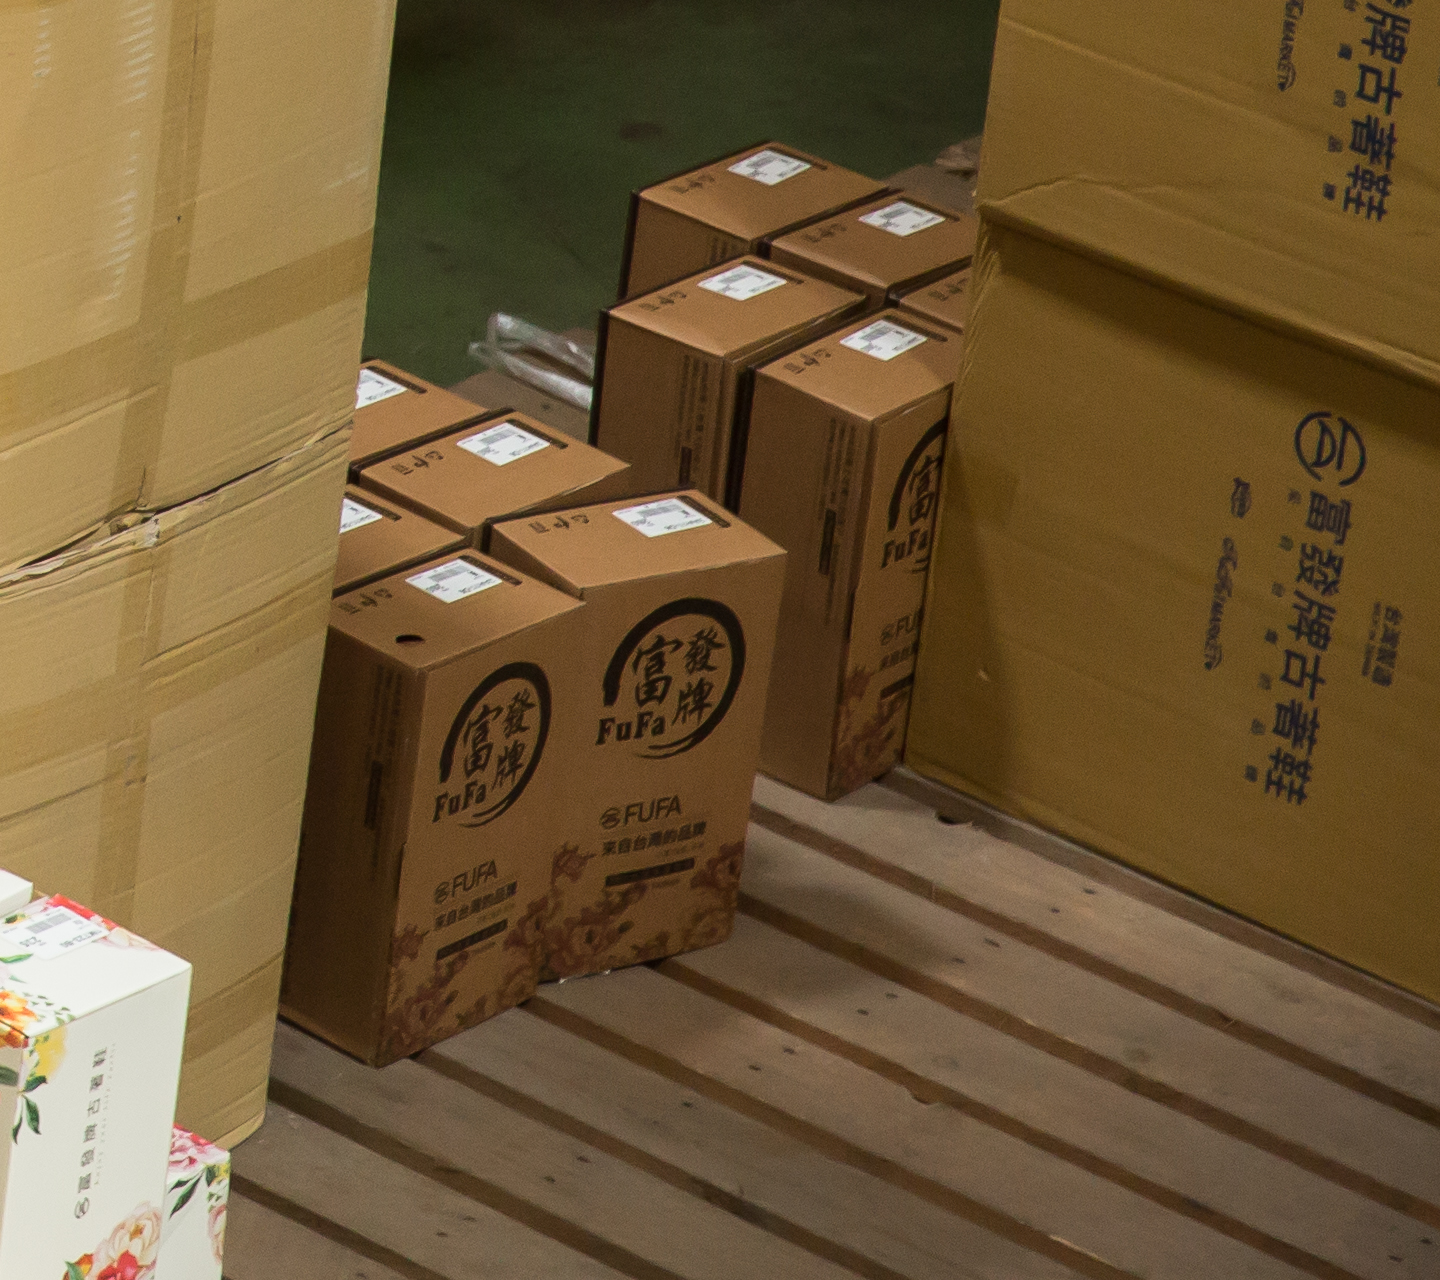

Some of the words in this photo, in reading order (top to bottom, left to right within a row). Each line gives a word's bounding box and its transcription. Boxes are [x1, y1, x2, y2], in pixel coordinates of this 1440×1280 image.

[1264, 491, 1352, 808] 富發牌古著鞋
[632, 627, 722, 728] 富發牌
[463, 689, 537, 790] 富發牌
[595, 712, 666, 746] FuFa
[433, 778, 488, 822] FuFa
[623, 795, 682, 827] FUFA
[452, 859, 498, 899] FUFA
